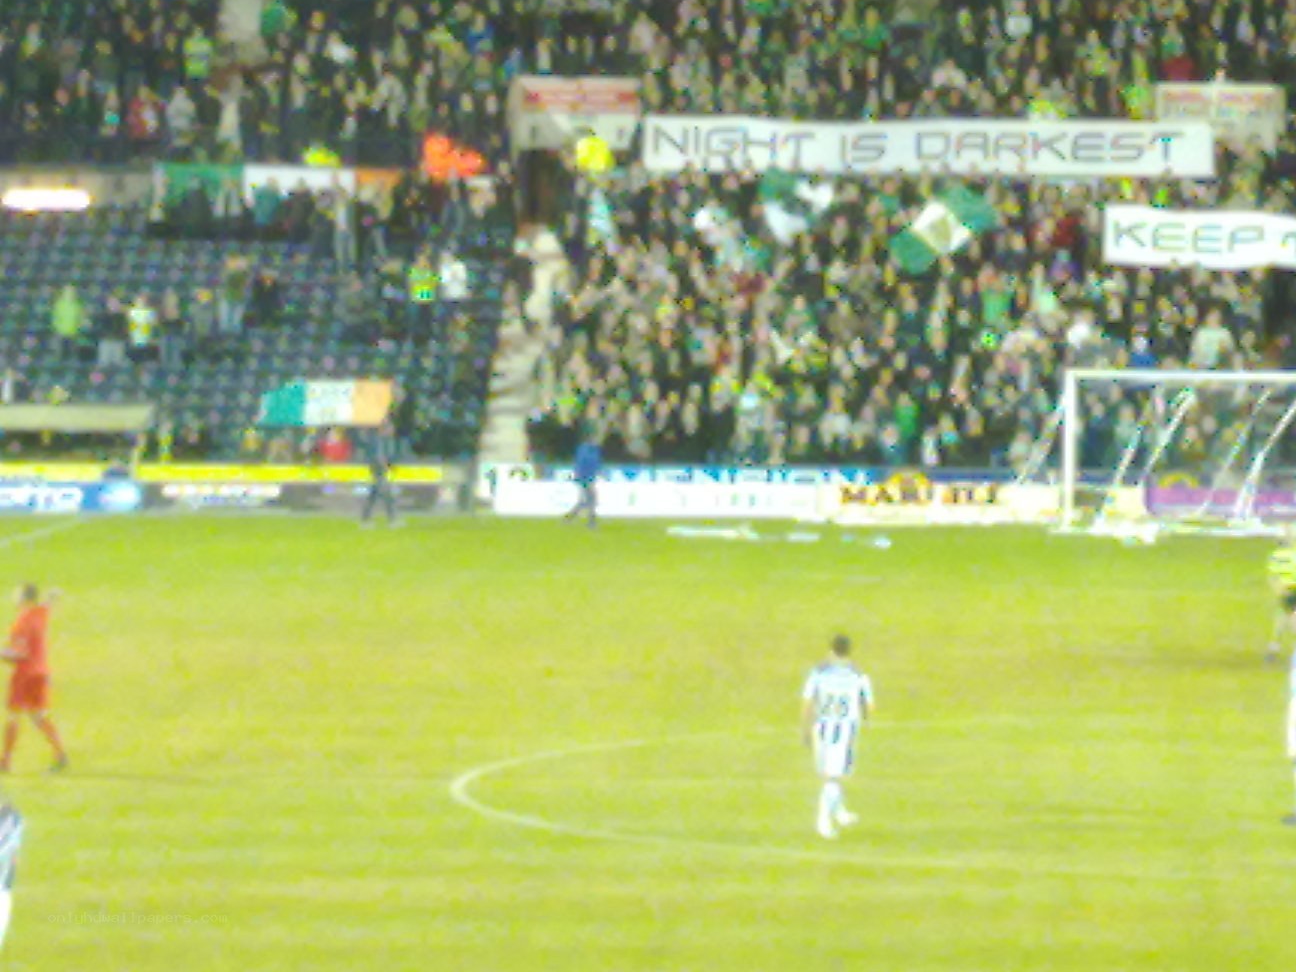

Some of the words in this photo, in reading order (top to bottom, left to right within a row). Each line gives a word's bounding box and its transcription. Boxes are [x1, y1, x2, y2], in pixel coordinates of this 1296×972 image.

[651, 125, 815, 161] NIGHT
[840, 131, 887, 162] IS
[913, 130, 1186, 162] DARKEST
[1112, 218, 1266, 255] KEEP
